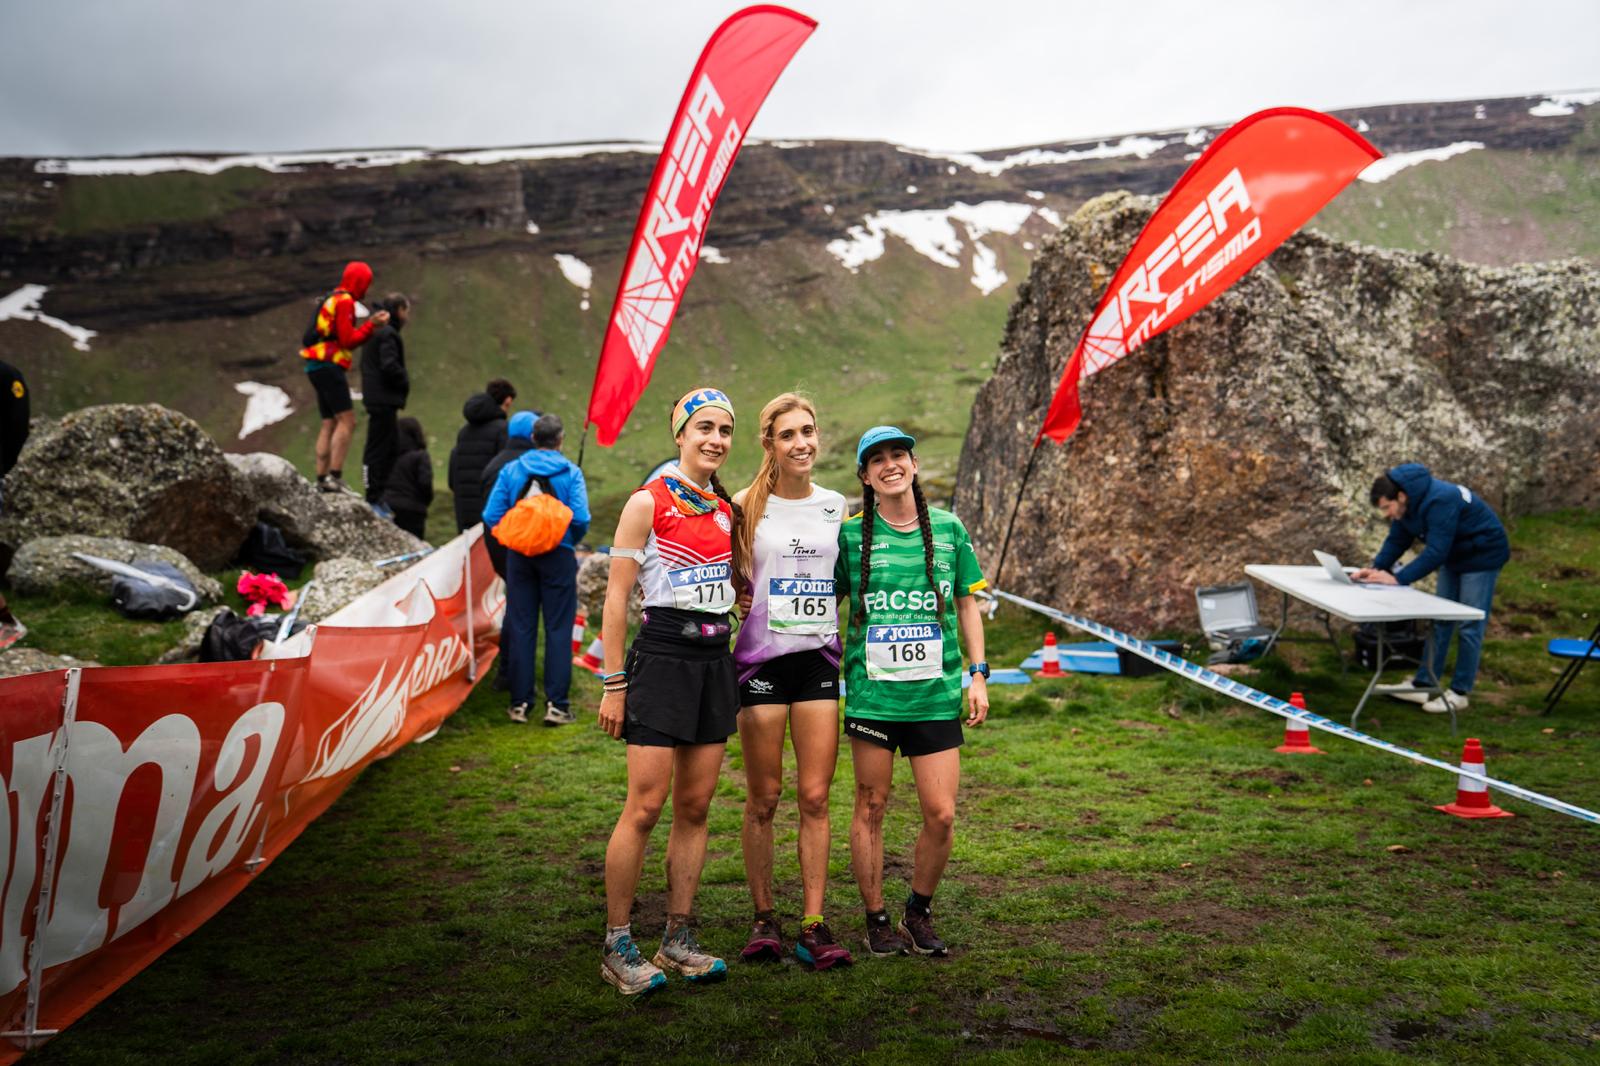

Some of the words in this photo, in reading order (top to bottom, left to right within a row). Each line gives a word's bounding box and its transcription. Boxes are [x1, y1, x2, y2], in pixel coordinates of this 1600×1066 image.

[643, 72, 726, 268] RFEA
[668, 117, 743, 294] ATLETISMO
[1118, 167, 1251, 328] RFEA
[1127, 216, 1262, 352] ATLETISMO
[694, 582, 724, 604] 171
[791, 597, 827, 617] 165
[888, 642, 926, 662] 168
[856, 724, 888, 741] SCARPA
